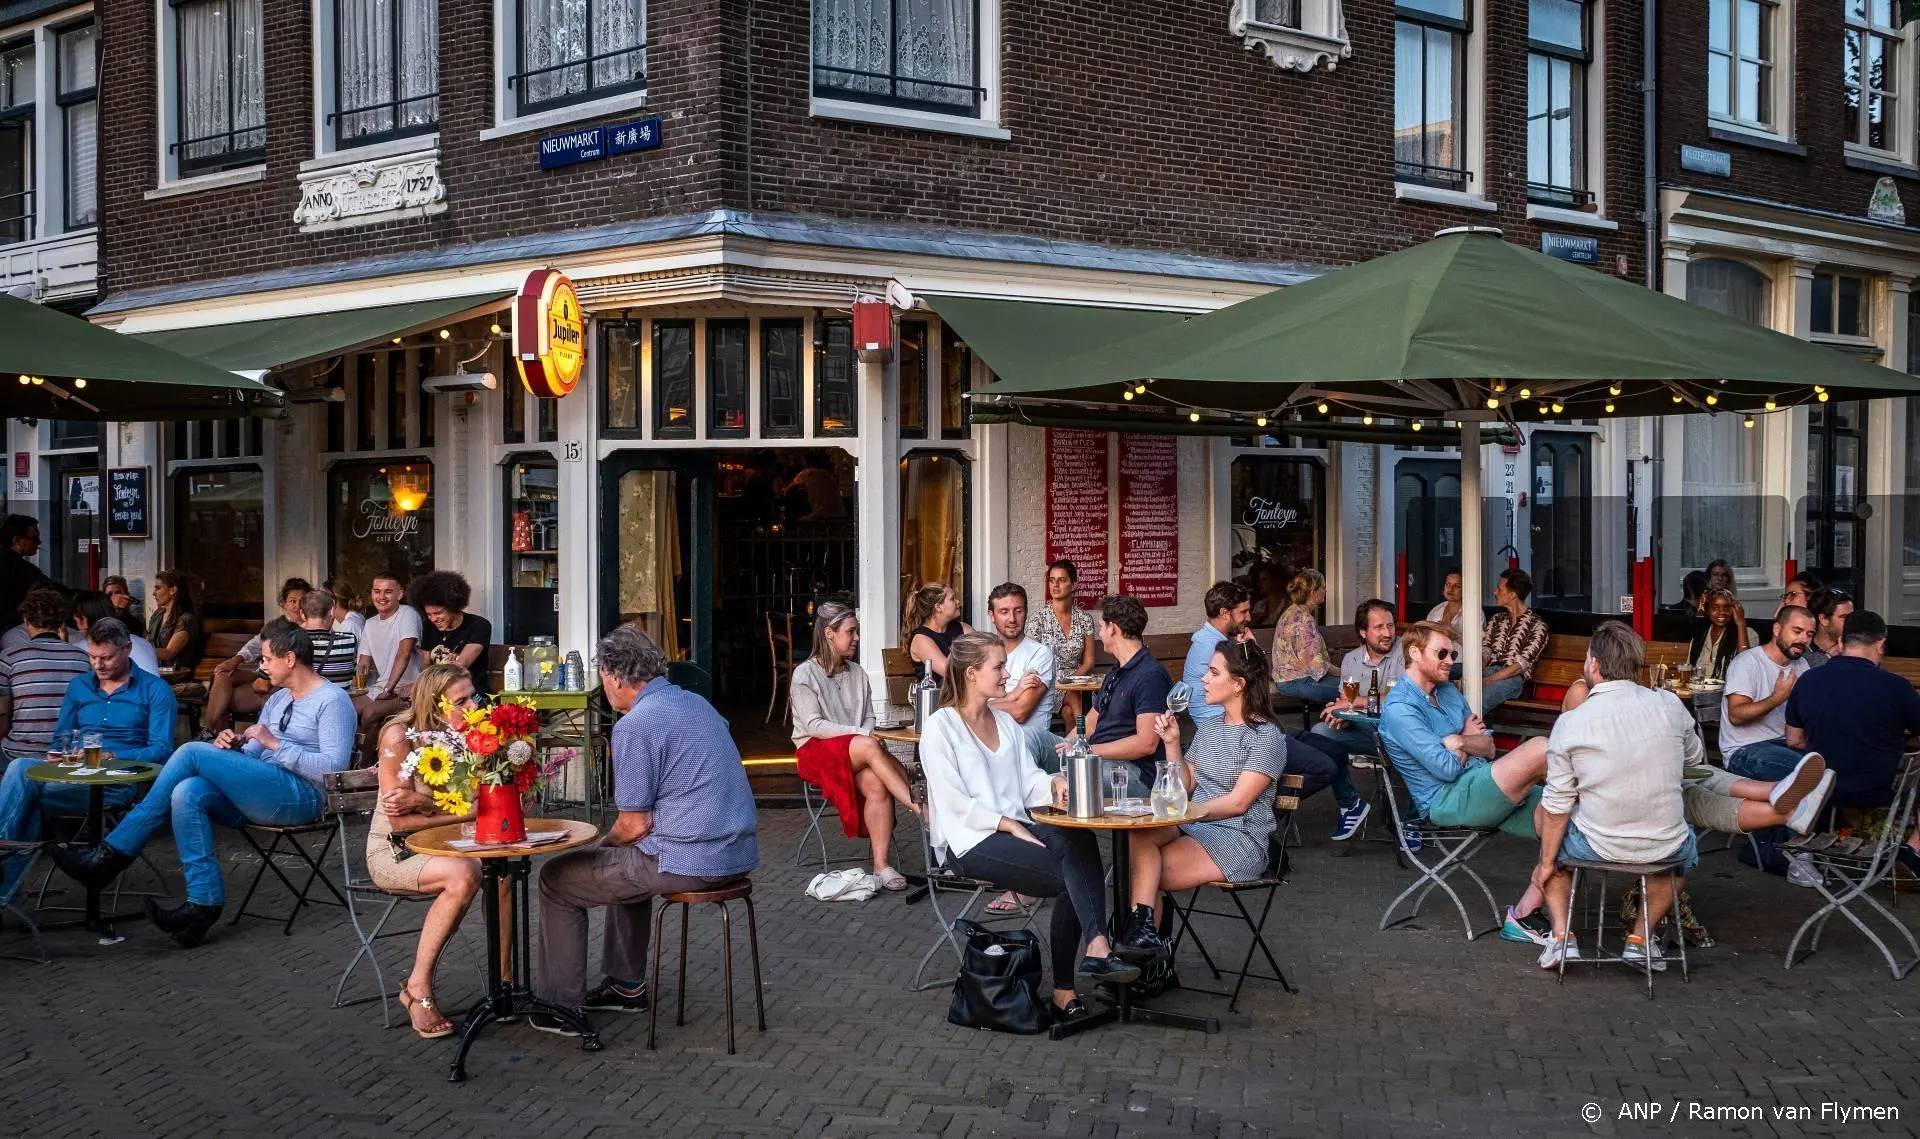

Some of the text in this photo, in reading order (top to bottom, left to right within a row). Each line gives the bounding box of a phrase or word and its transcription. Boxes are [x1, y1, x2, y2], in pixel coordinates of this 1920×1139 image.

[542, 130, 600, 155] NIEUWMARKT
[614, 125, 652, 147] 新廣場
[580, 148, 600, 159] Centrum
[406, 175, 434, 193] 1727
[303, 192, 333, 209] ANNO
[1548, 235, 1592, 251] NIEUWMARKT
[1571, 251, 1592, 260] CENTRUM
[552, 318, 580, 344] Jupiler
[564, 443, 579, 460] 15
[1505, 463, 1515, 477] 23
[1505, 480, 1514, 494] 21
[352, 498, 418, 541] Fonteyn
[1242, 496, 1297, 528] Fonteyn
